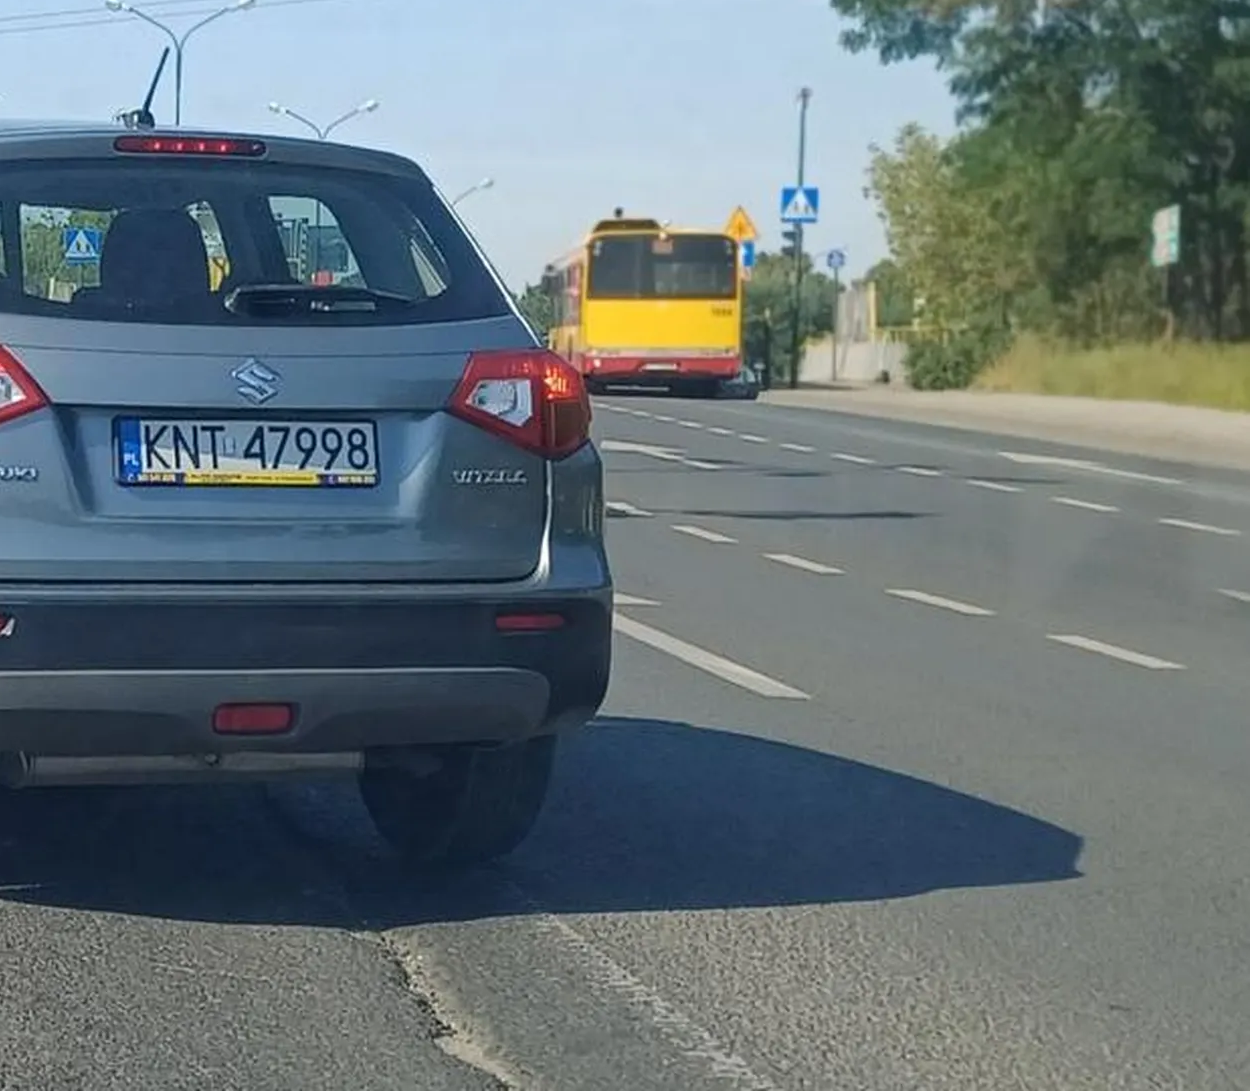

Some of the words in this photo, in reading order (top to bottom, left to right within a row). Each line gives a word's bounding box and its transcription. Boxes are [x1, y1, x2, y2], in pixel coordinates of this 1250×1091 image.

[123, 453, 140, 466] PL
[144, 424, 225, 469] KNT
[243, 425, 370, 470] 47998
